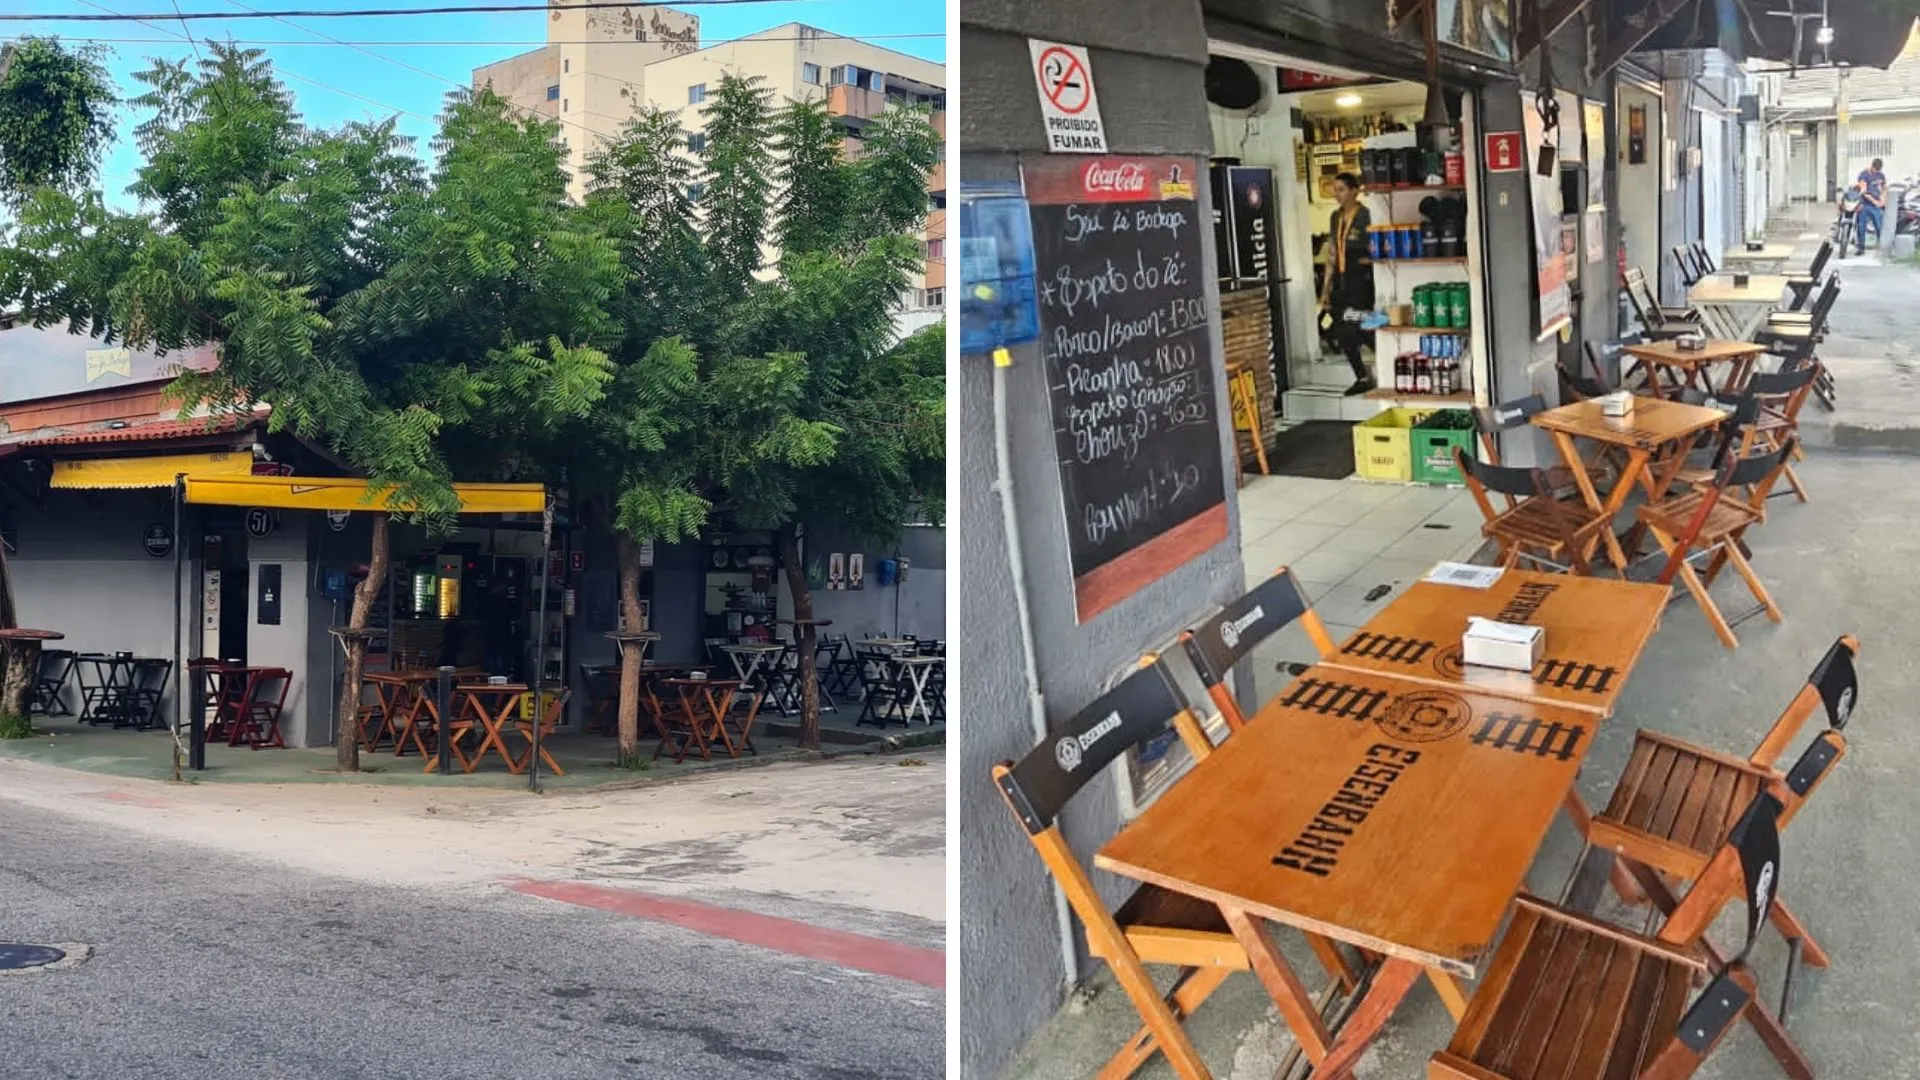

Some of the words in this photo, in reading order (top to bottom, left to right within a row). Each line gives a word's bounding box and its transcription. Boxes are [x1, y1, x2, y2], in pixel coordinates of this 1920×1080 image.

[1049, 117, 1099, 132] PROIBIDO
[1053, 134, 1103, 150] FUMAR
[1133, 249, 1159, 291] do
[251, 511, 268, 533] 51
[1270, 742, 1422, 878] EISENBAHN
